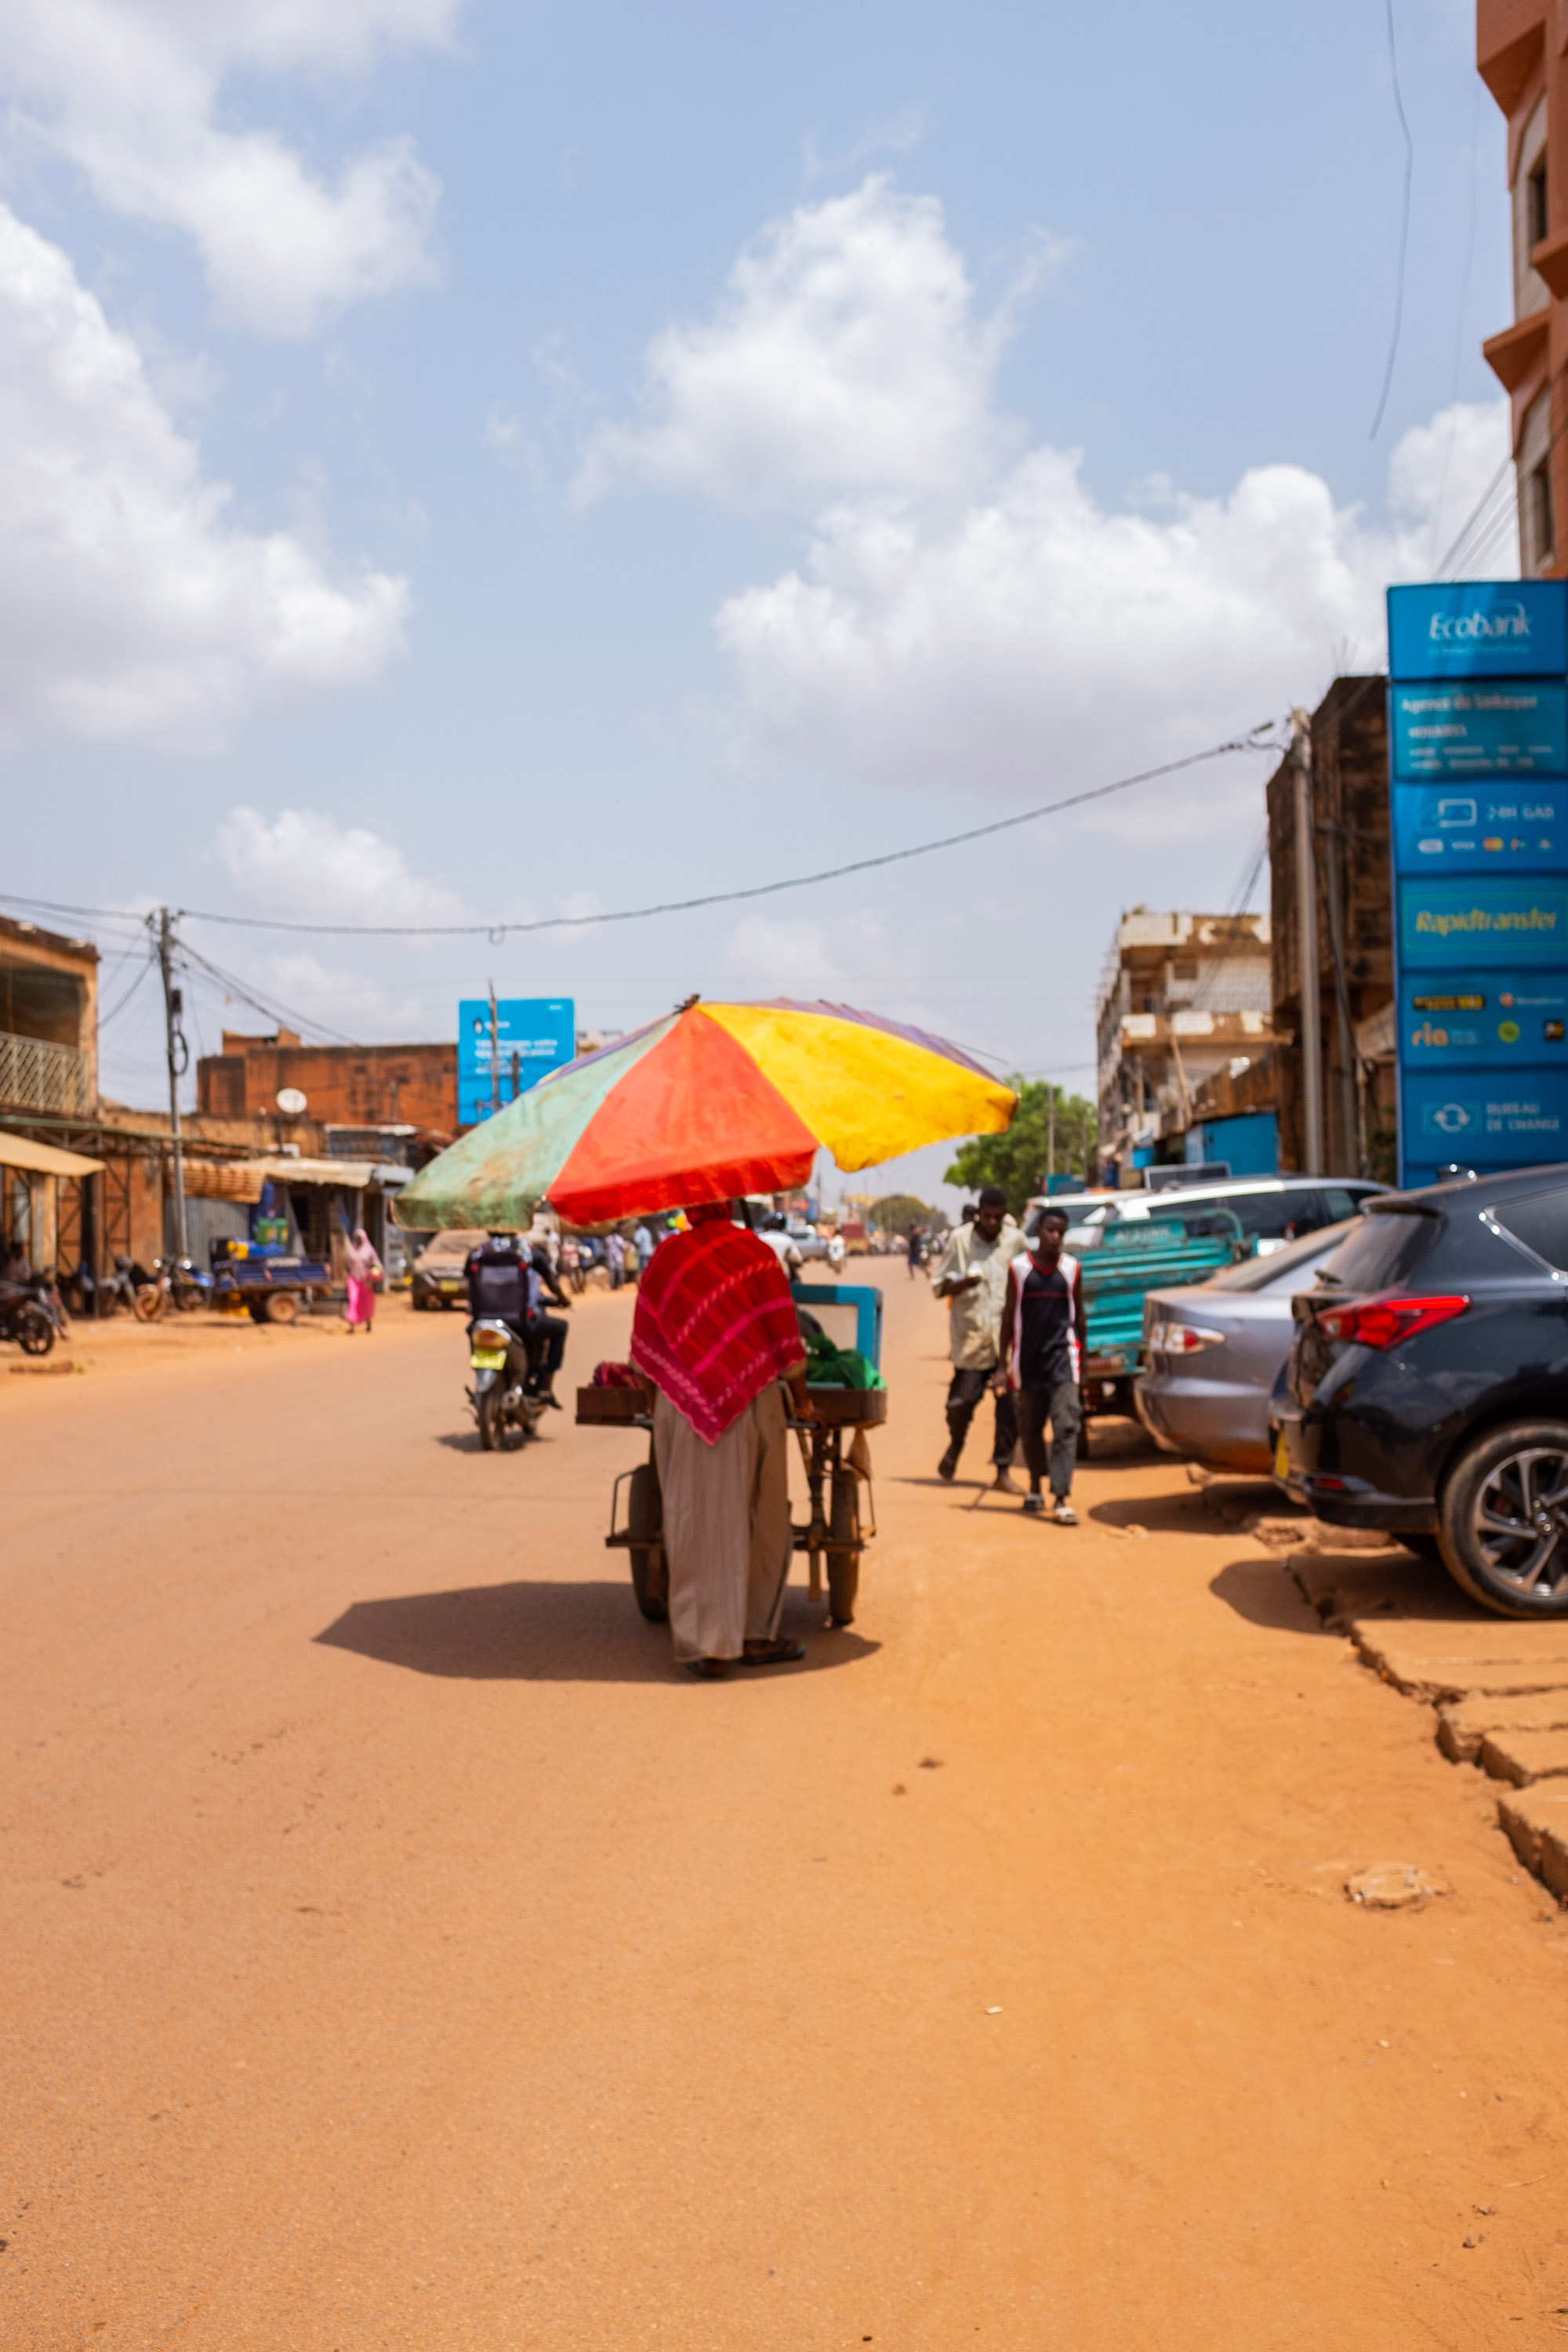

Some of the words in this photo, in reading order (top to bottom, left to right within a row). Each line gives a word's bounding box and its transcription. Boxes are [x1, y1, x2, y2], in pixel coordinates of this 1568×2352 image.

[1429, 604, 1532, 640] Ecobank
[1415, 907, 1557, 937] Rapidtransfer
[1411, 1021, 1449, 1047] ria
